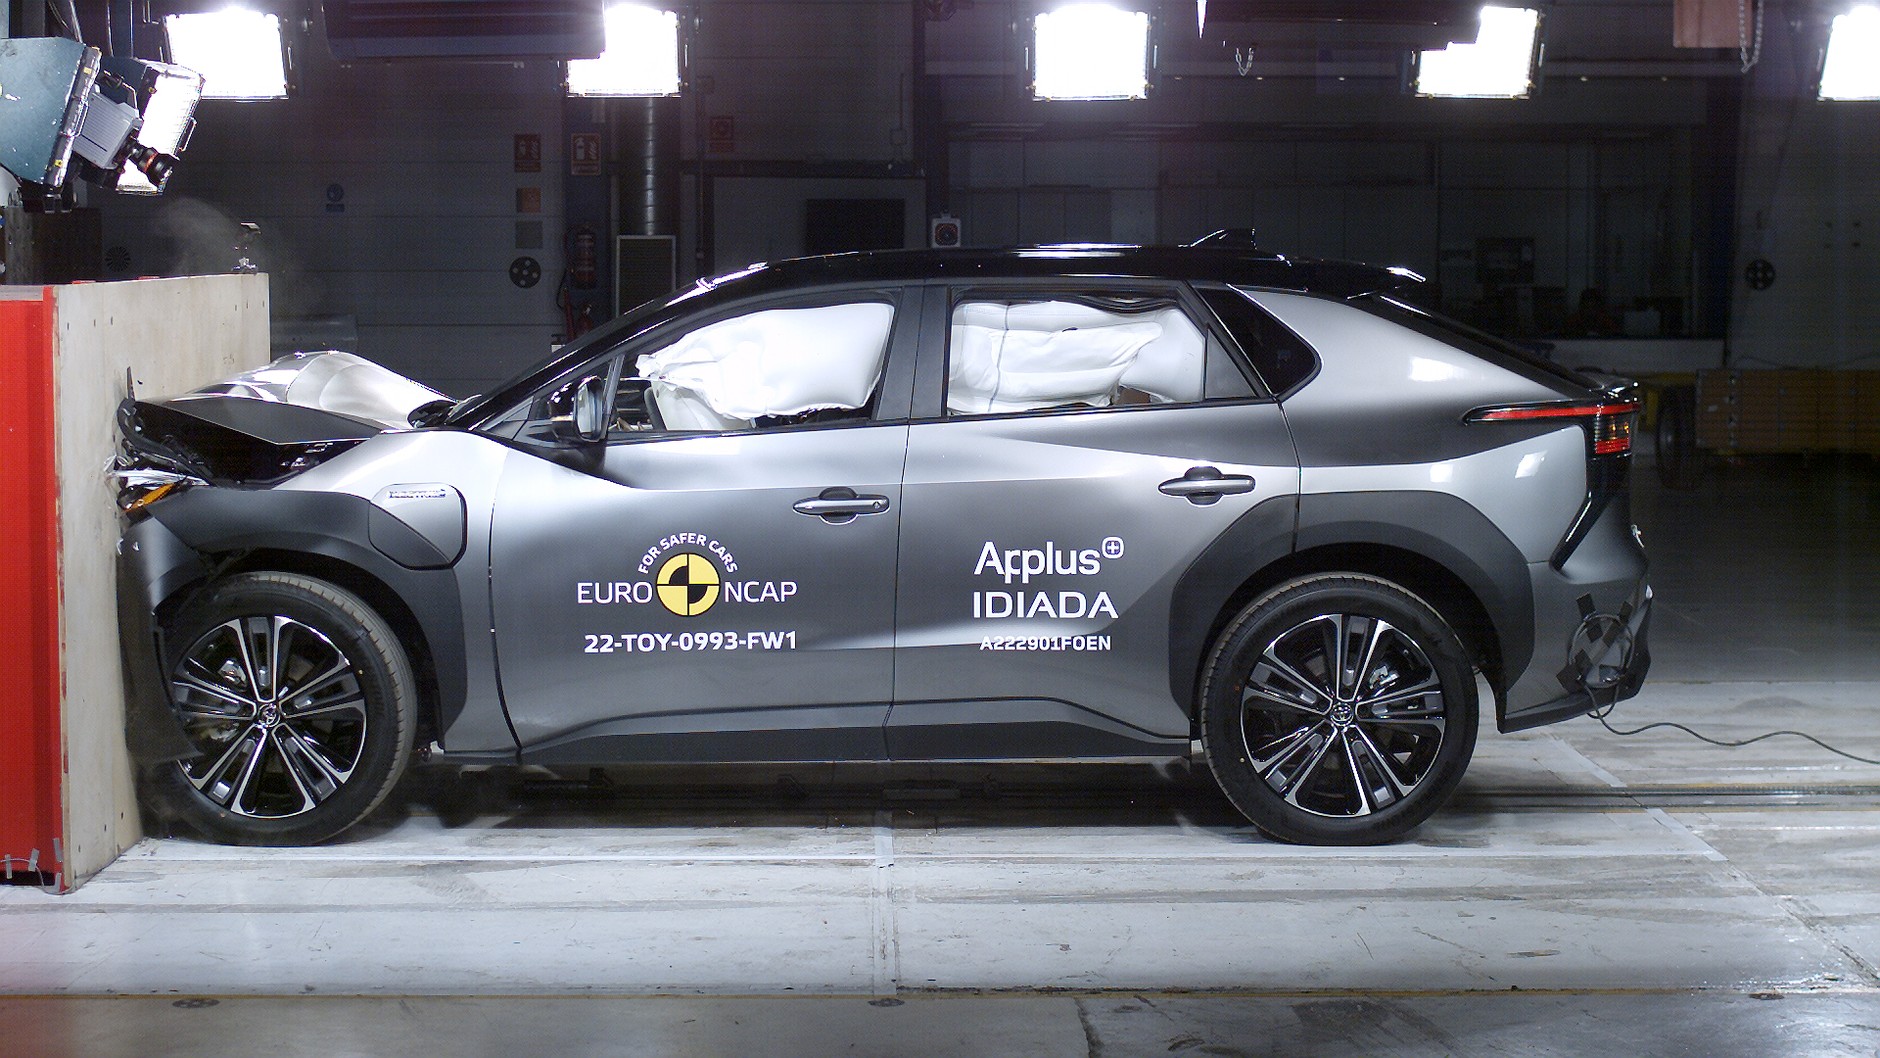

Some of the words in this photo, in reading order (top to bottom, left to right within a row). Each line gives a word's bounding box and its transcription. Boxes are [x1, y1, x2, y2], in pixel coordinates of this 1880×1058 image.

[638, 546, 661, 574] FOR
[660, 532, 707, 551] SAFER
[708, 540, 738, 573] CARS
[577, 582, 653, 604] EURO
[725, 581, 798, 603] NCAP
[973, 591, 1119, 619] IDIADA
[584, 630, 797, 653] 22-TOY-0993-FW1
